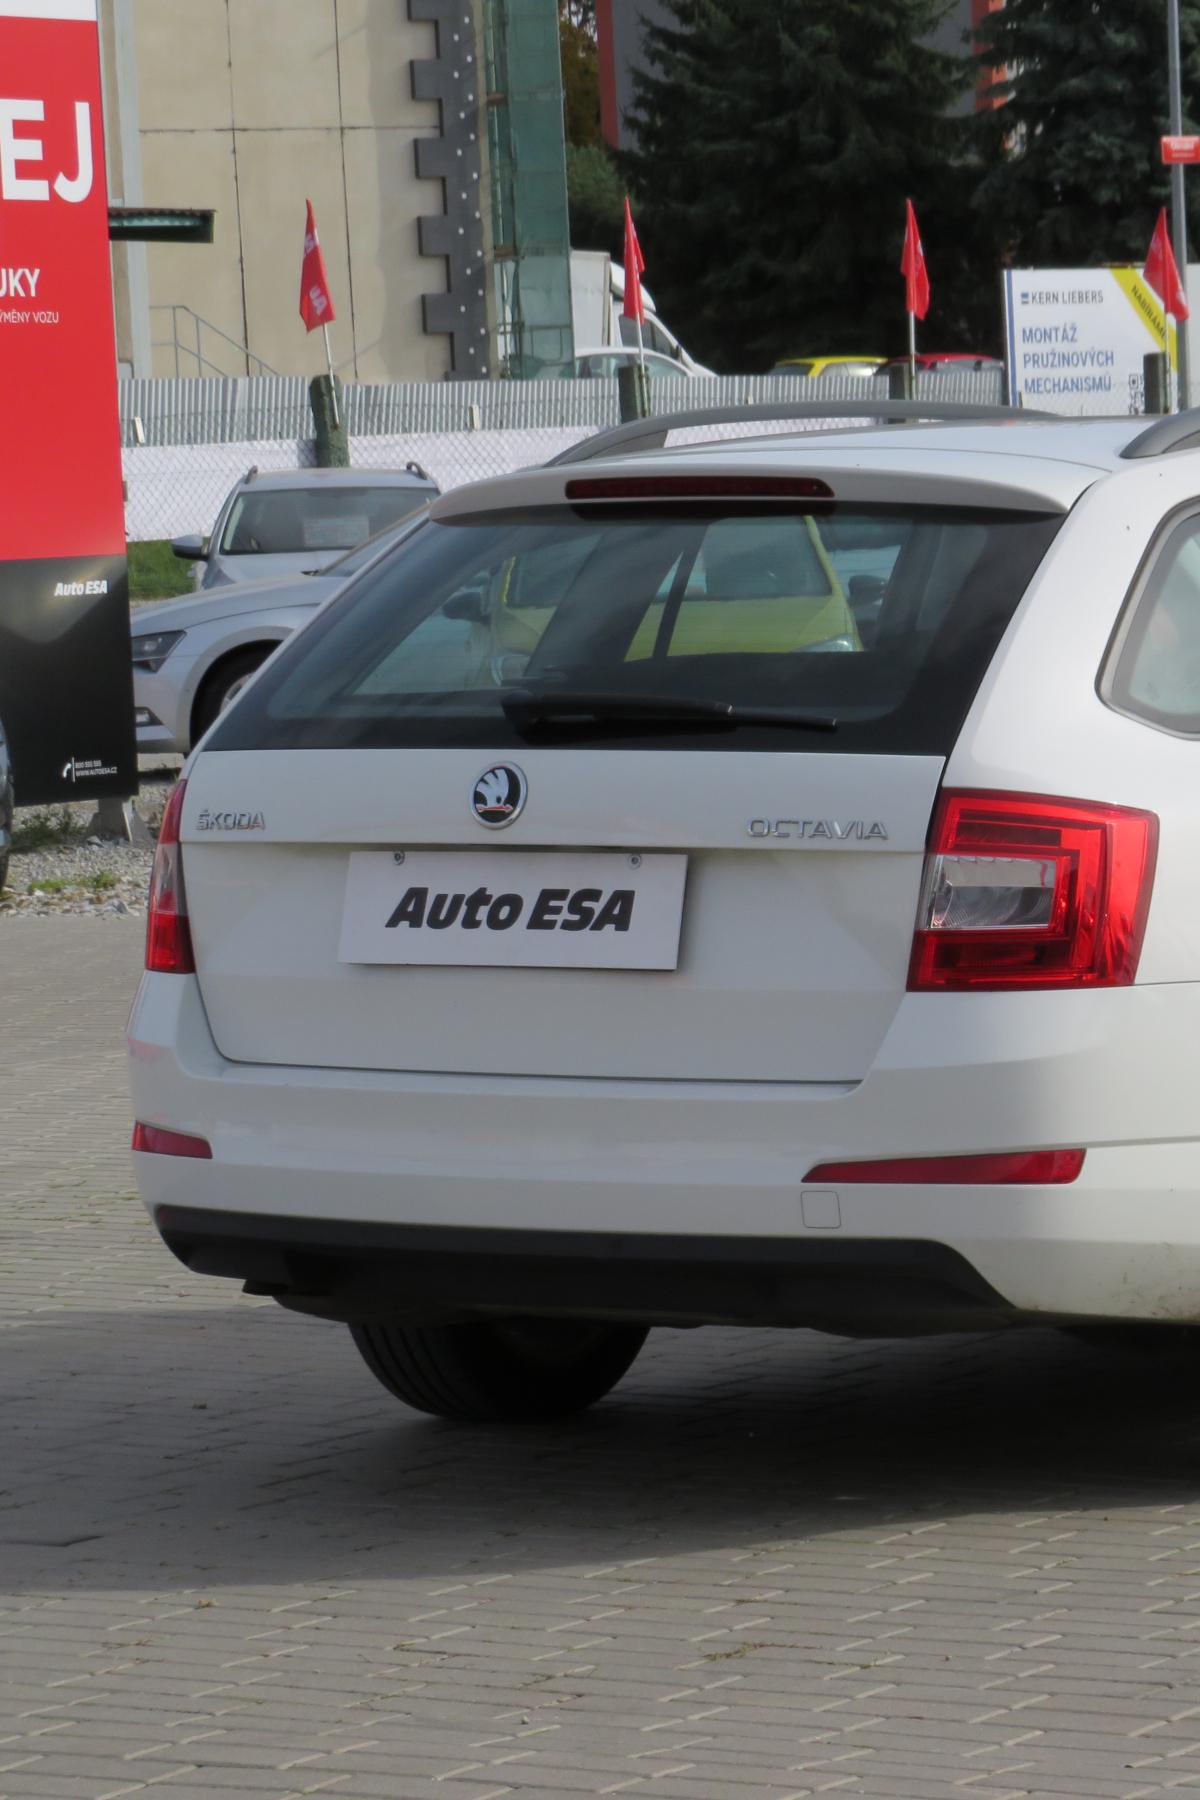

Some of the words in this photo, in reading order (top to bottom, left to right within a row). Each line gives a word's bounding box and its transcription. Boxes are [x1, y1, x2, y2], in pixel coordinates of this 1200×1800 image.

[1031, 291, 1059, 305] KERN
[1062, 289, 1104, 304] LIEBERS
[32, 311, 59, 323] VOZU
[1022, 322, 1078, 344] MONTÁŽ
[1023, 347, 1114, 368] PRUŽINOVÝCH
[1024, 371, 1112, 394] MECHANISMŮ
[54, 582, 84, 596] Auto
[85, 580, 108, 594] ESA
[196, 809, 266, 831] ŠKODA
[748, 818, 889, 841] OCTAVIA
[384, 887, 524, 931] Auto
[526, 888, 636, 932] ESA
